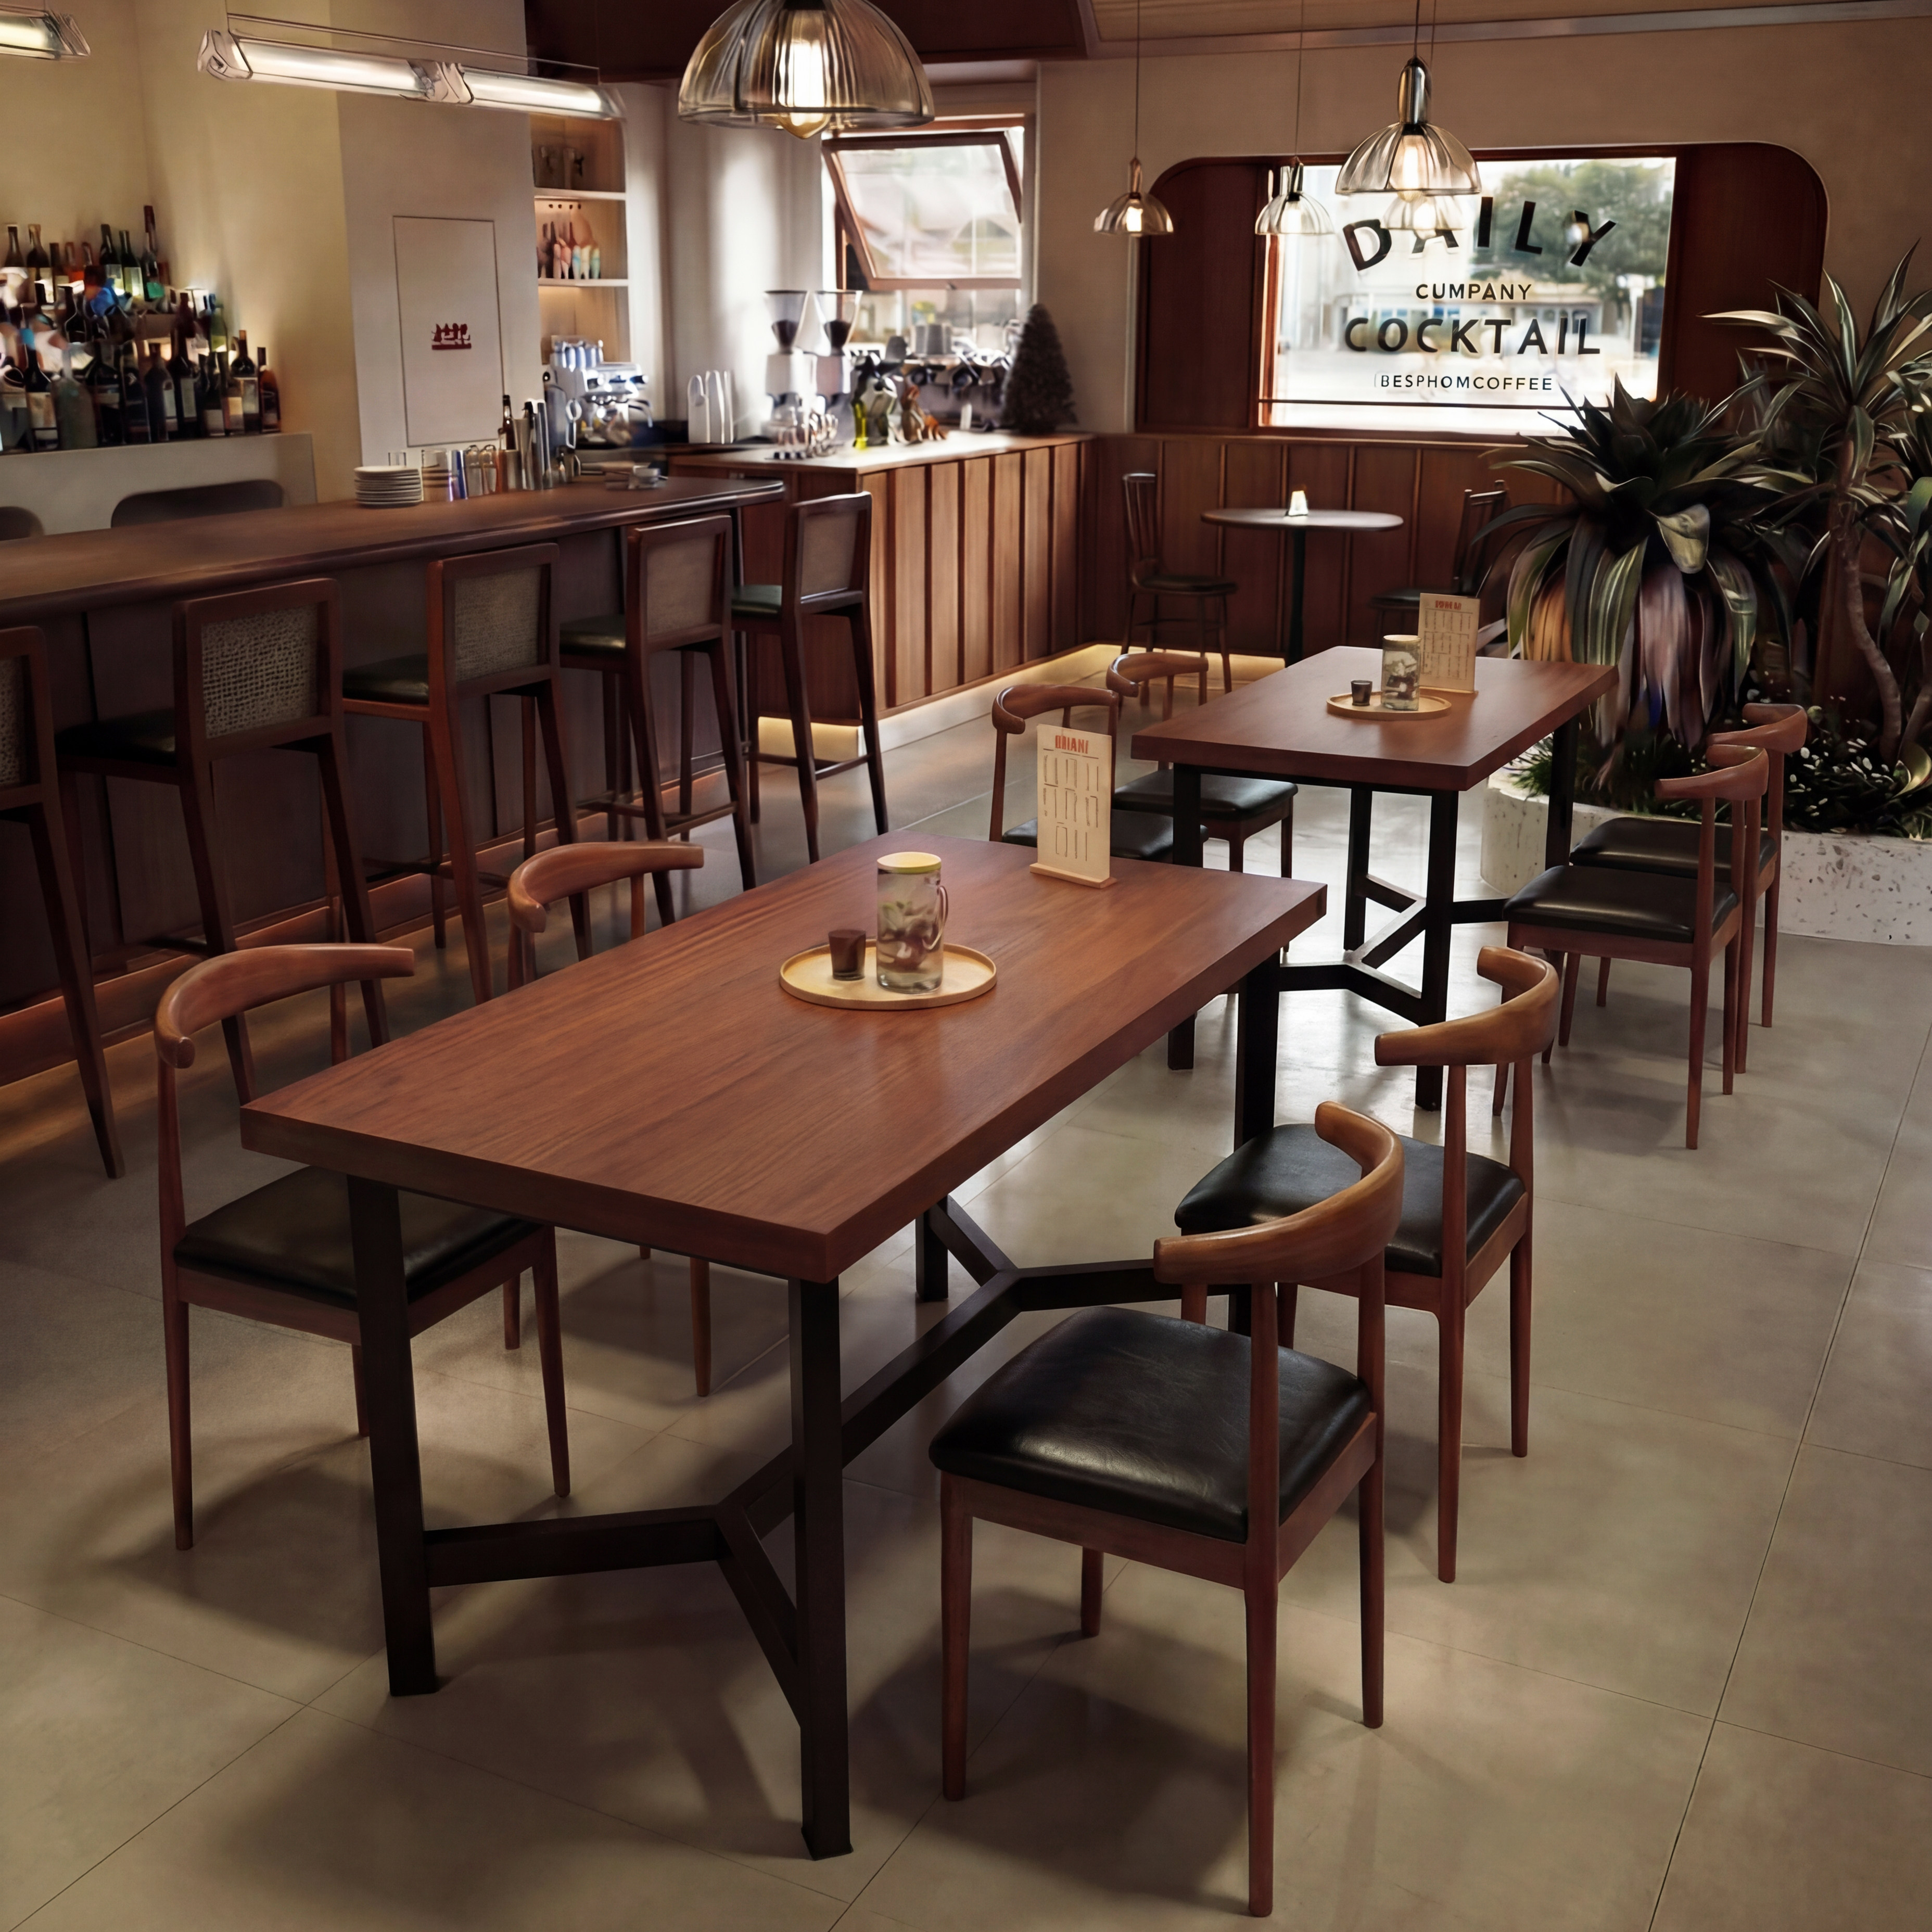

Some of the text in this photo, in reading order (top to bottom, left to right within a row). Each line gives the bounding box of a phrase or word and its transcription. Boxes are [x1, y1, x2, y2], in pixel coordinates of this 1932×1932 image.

[1416, 283, 1532, 300] CUMPANY
[1344, 316, 1600, 355] COCKTAIL
[1381, 375, 1552, 390] BESPHOMCOFFEE
